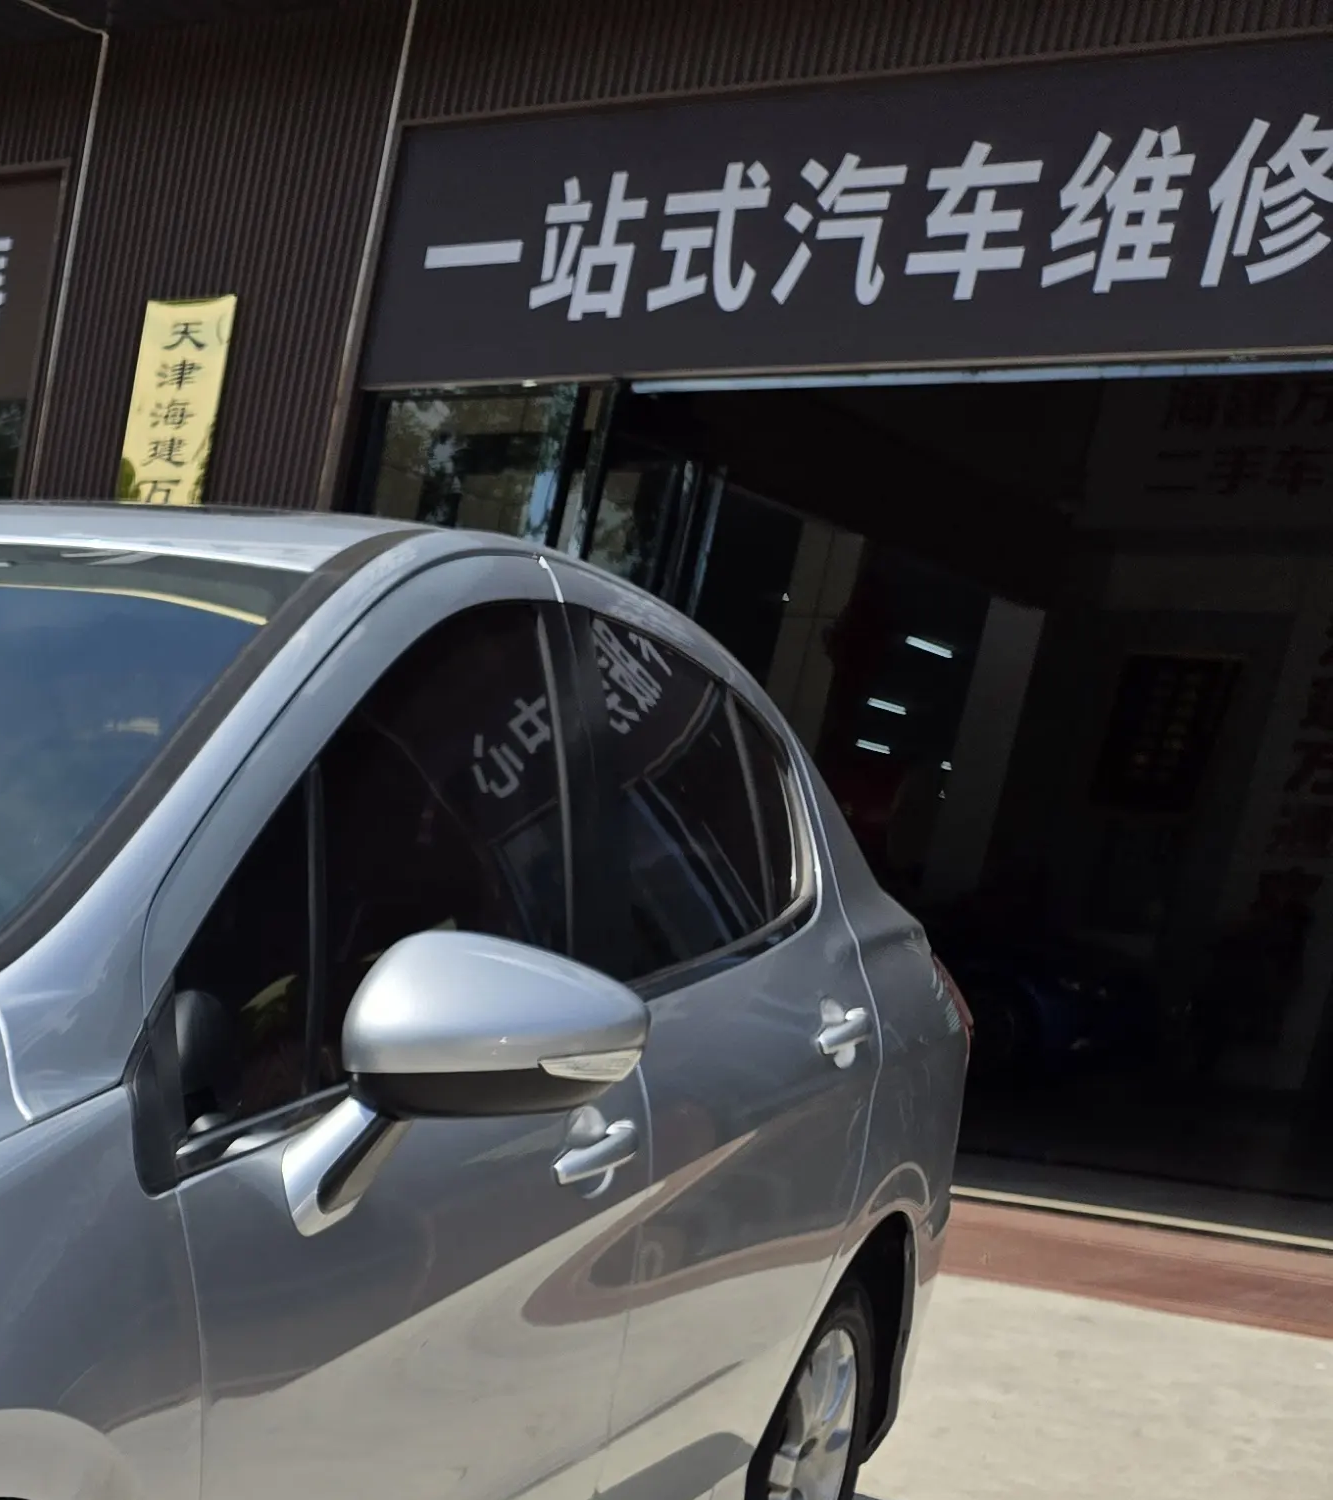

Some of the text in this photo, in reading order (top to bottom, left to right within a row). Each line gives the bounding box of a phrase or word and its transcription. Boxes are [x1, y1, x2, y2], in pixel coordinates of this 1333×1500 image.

[423, 111, 1333, 323] 一站式汽车维修
